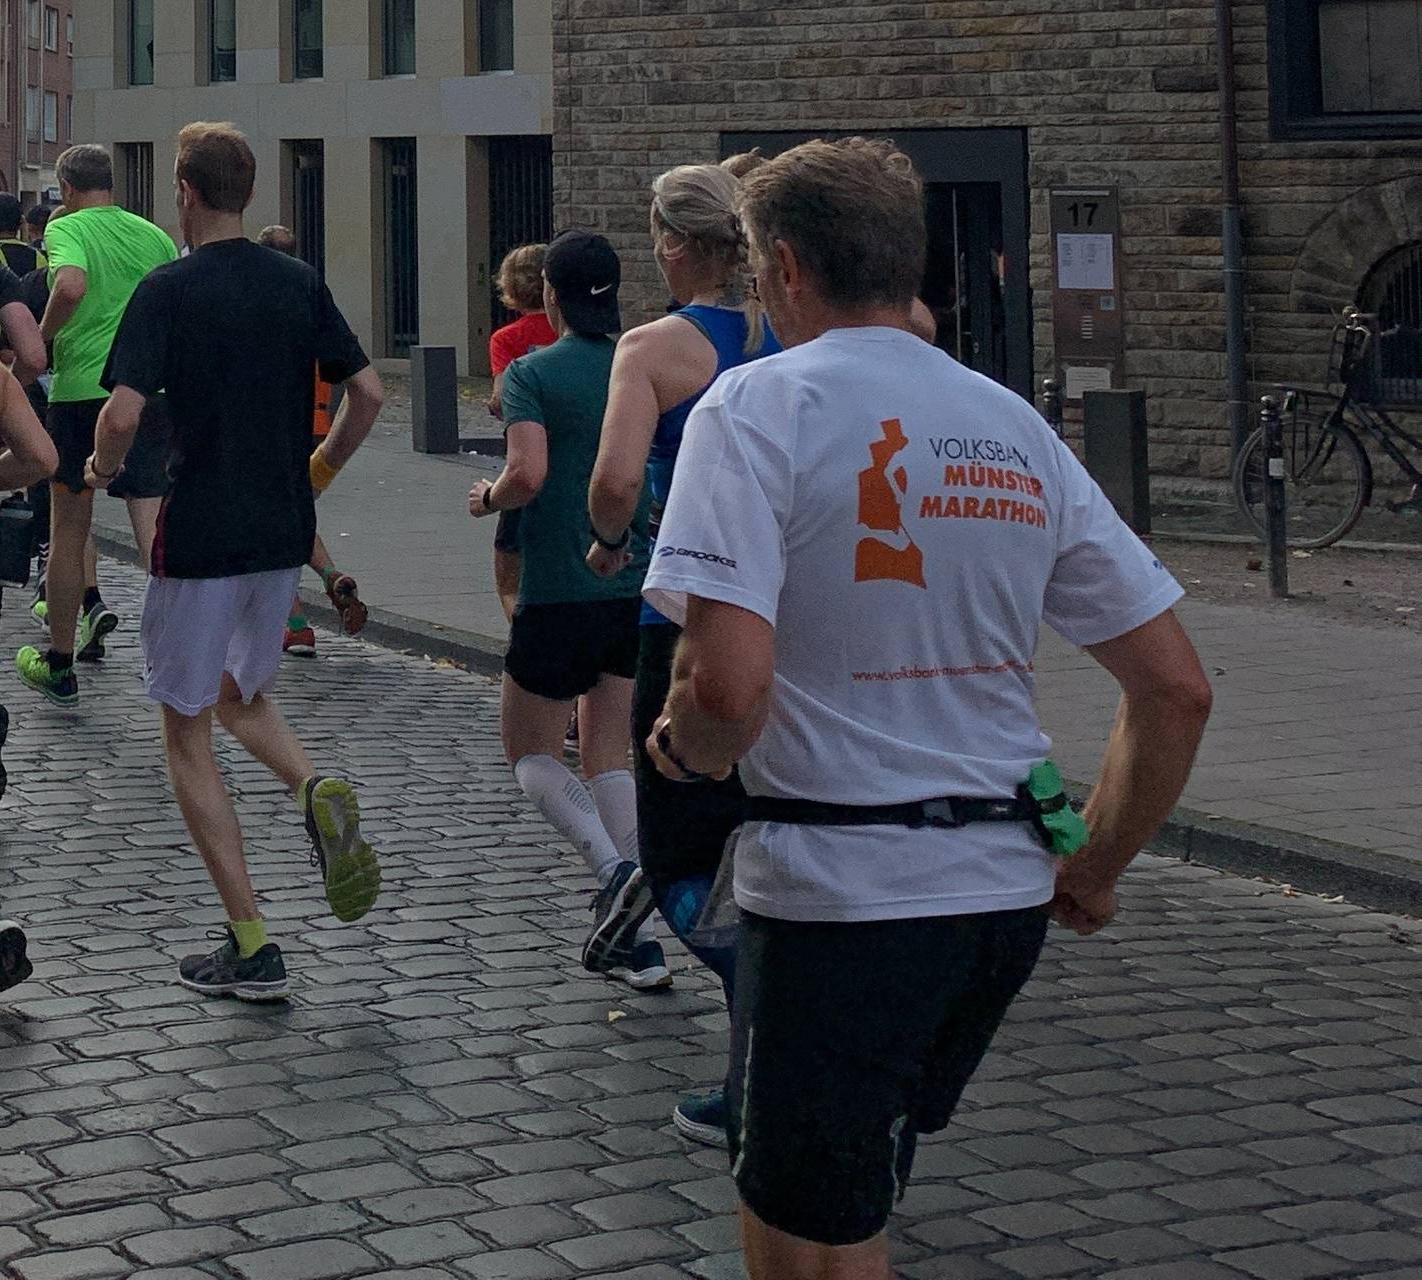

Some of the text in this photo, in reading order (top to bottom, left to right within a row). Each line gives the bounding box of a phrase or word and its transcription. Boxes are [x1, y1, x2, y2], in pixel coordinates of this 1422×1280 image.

[1067, 202, 1099, 227] 17
[928, 438, 1032, 470] VOLKSBAN
[943, 460, 1043, 500] MÜNSTER
[919, 495, 1047, 530] MARATHON
